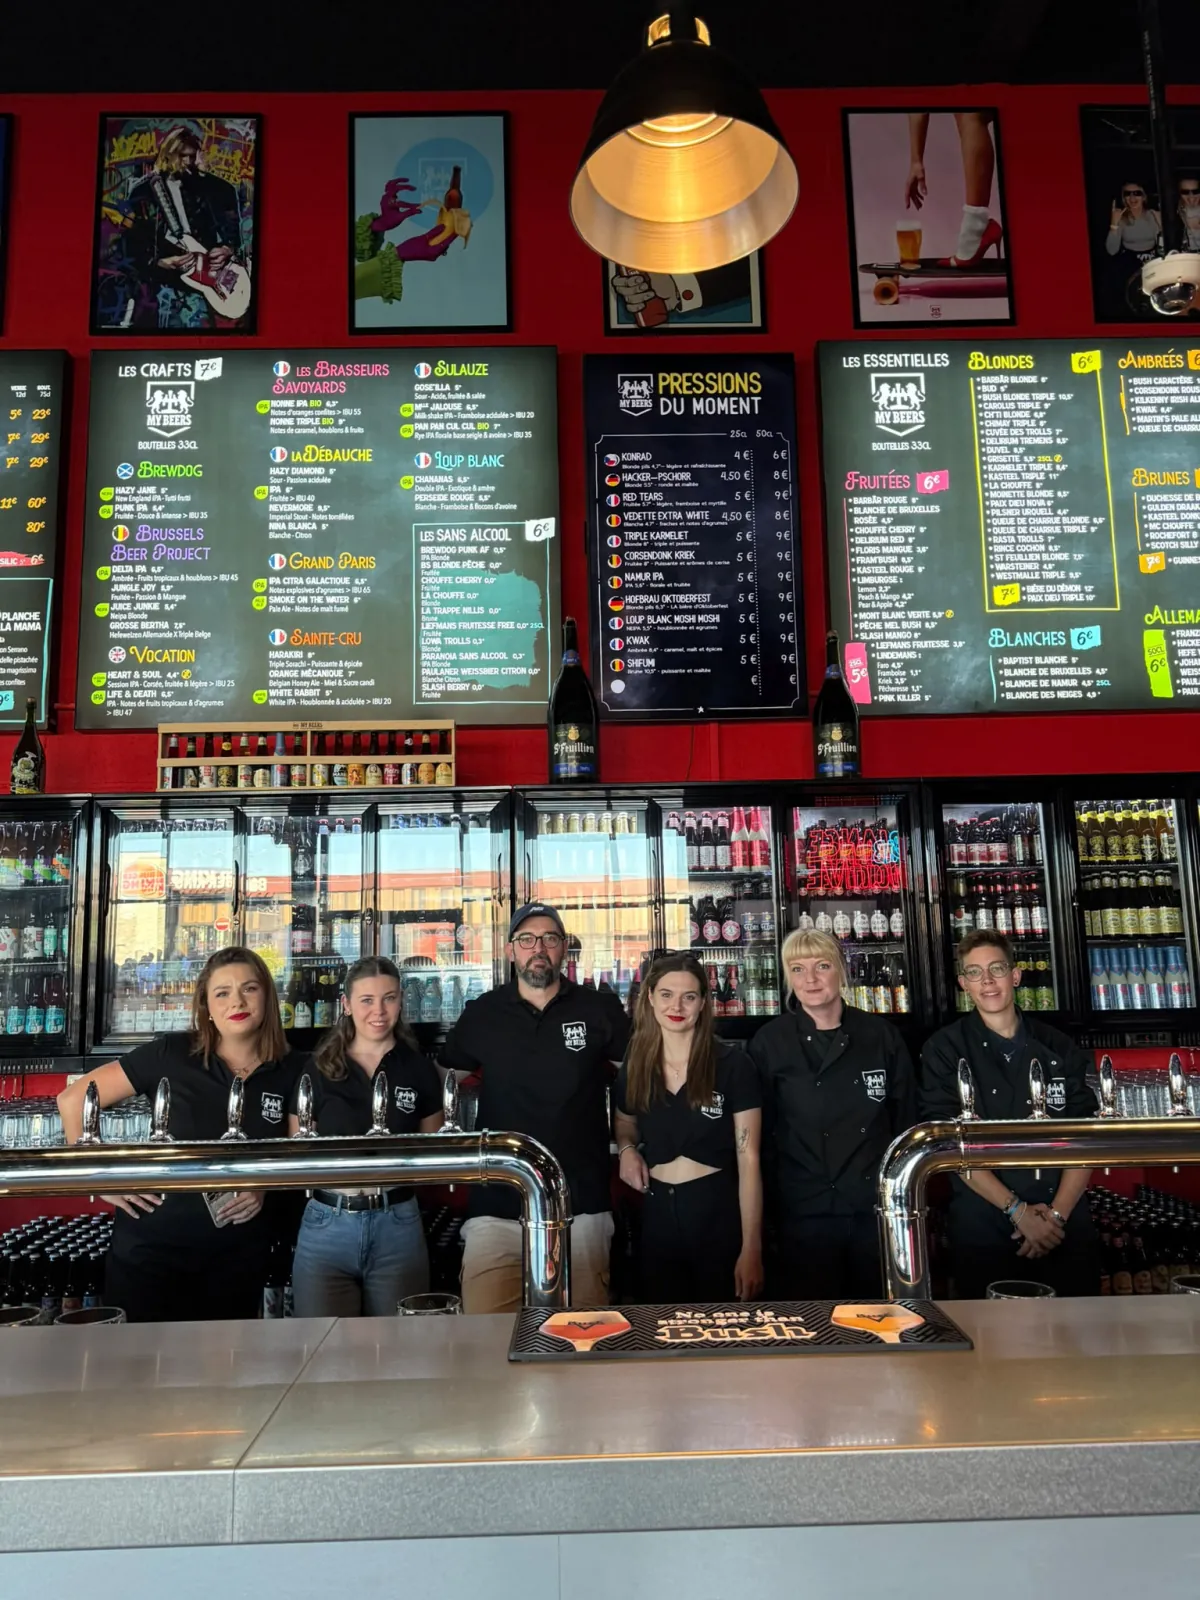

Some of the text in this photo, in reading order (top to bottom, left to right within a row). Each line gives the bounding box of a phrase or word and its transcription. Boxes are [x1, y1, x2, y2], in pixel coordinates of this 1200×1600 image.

[843, 354, 949, 368] LES ESSENTIELLES
[968, 352, 1034, 370] BLONDES
[1118, 349, 1184, 368] AMBRÉES
[119, 366, 136, 377] LES
[140, 363, 191, 377] CRAFTS
[296, 361, 390, 378] LES BRASSEURS
[434, 360, 488, 376] SULAUZE
[272, 378, 346, 394] SAVOYARDS
[659, 372, 762, 394] PRESSIONS
[631, 399, 652, 407] BEERS
[660, 397, 761, 415] DU MOMENT
[32, 409, 50, 420] 23€
[147, 414, 192, 426] MY BEERS
[875, 411, 925, 423] MY BEERS
[30, 433, 49, 443] 29€
[138, 441, 176, 450] BOUTEILLES
[872, 442, 910, 450] BOUTEILLES
[303, 446, 373, 462] DÉBAUCHE
[622, 452, 652, 461] KONRAD
[30, 457, 48, 468] 29€
[435, 452, 504, 471] LOUP BLANC
[137, 461, 202, 478] BREWDOG
[845, 470, 910, 490] FRUITÉES
[1132, 468, 1190, 487] BRUNES
[28, 497, 46, 508] 60€
[622, 493, 637, 501] RED
[639, 492, 663, 501] TEARS
[624, 512, 656, 520] VEDETTE
[658, 511, 683, 520] EXTRA
[686, 511, 709, 519] WHITE
[26, 522, 45, 532] 80€
[136, 525, 204, 542] BRUSSELS
[420, 531, 434, 542] LES
[437, 529, 466, 541] SANS
[470, 528, 512, 541] ALCOOL
[624, 532, 648, 540] TRIPLE
[650, 531, 688, 540] KARMELIET
[111, 544, 210, 561] BEER PROJECT
[624, 551, 695, 560] CORSENDONK KRIEK
[288, 552, 376, 569] GRAND PARIS
[625, 572, 664, 581] NAMUR IPA
[662, 594, 711, 603] OKTOBERFEST
[2, 612, 40, 621] PLANCHE
[626, 614, 720, 624] LOUP BLANC MOSHI MOSHI
[14, 622, 41, 630] MAMA
[626, 636, 650, 644] KWAK
[988, 628, 1066, 648] BLANCHES
[130, 646, 195, 662] VOCATION
[627, 658, 655, 668] SHIFUMI
[657, 1317, 749, 1326] stronger
[654, 1322, 818, 1342] Bush
